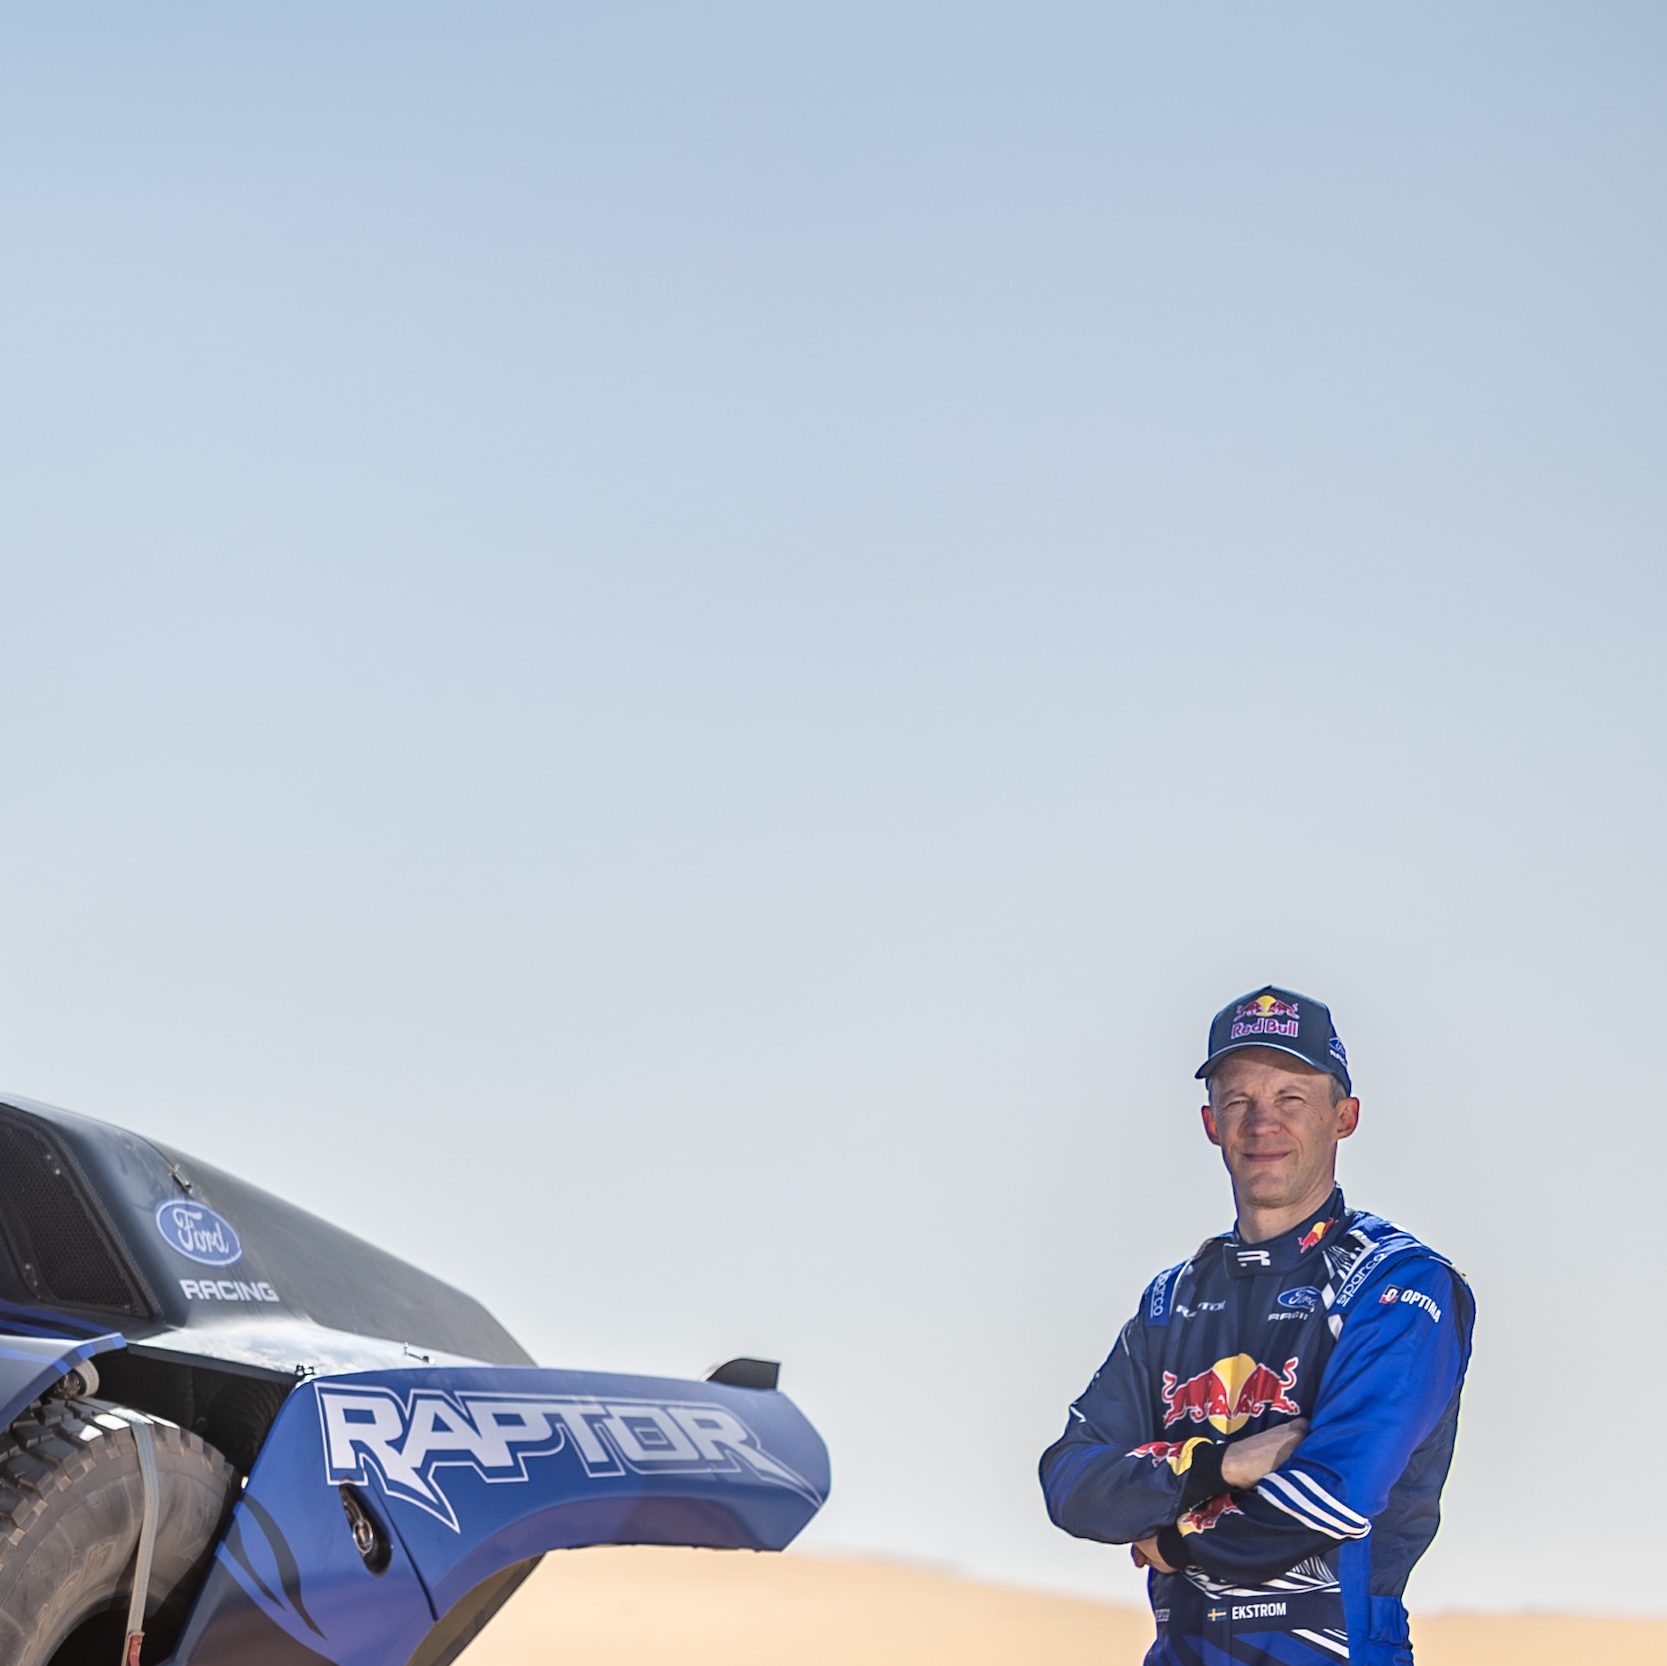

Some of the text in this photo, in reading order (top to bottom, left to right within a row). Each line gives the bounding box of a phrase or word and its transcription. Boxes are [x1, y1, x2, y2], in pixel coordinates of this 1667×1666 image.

[1231, 1018, 1298, 1039] Red Bull
[172, 1208, 229, 1254] Ford
[179, 1280, 280, 1302] RACING
[1336, 1252, 1387, 1307] sparco
[1400, 1289, 1442, 1323] OPTIMA
[313, 1382, 825, 1532] RAPTOR
[1232, 1602, 1287, 1620] EKSTROM
